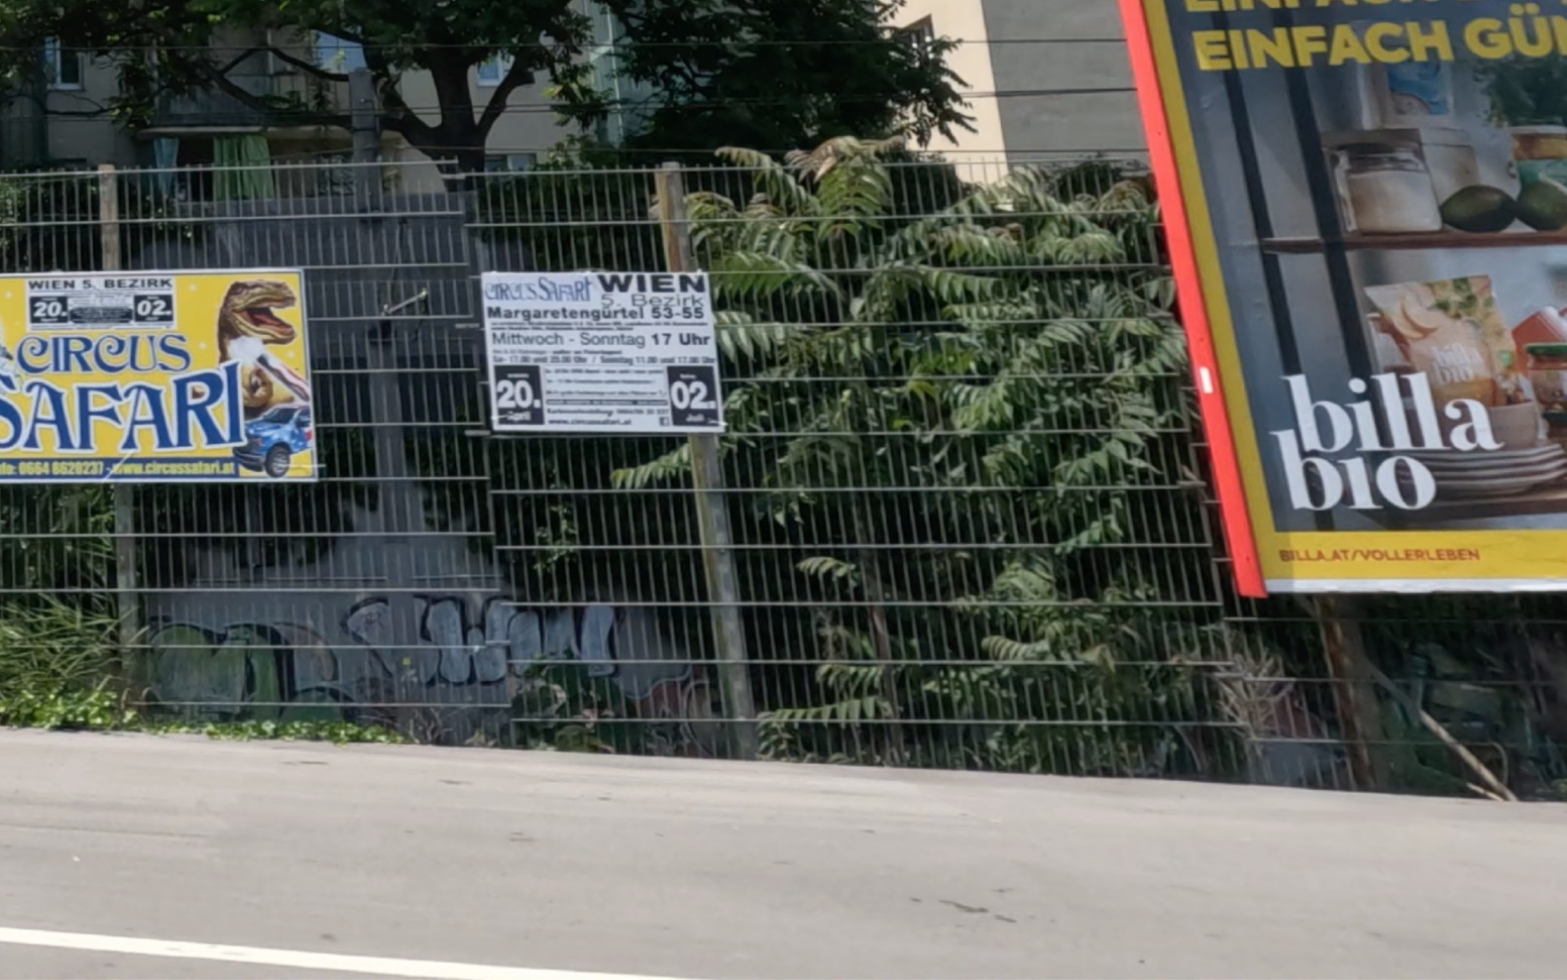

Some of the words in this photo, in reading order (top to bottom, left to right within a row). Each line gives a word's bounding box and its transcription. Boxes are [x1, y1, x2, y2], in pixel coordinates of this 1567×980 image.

[1191, 20, 1455, 72] EINFACH
[28, 279, 76, 290] WIEN
[104, 277, 173, 289] BEZIRK
[597, 274, 706, 293] WIEN
[33, 301, 68, 318] 20.
[137, 299, 172, 317] 02.
[601, 293, 622, 307] 5.
[631, 293, 704, 308] Bezirk
[487, 305, 644, 322] Margaretengürtel
[651, 306, 705, 319] 53-55
[492, 331, 565, 346] Mittwoch
[580, 332, 646, 350] Sonntag
[651, 332, 672, 346] 17
[679, 332, 711, 346] Uhr
[16, 334, 192, 374] CIRCUS
[496, 378, 542, 409] 20.
[1280, 371, 1506, 454] billa
[1269, 428, 1438, 511] bio
